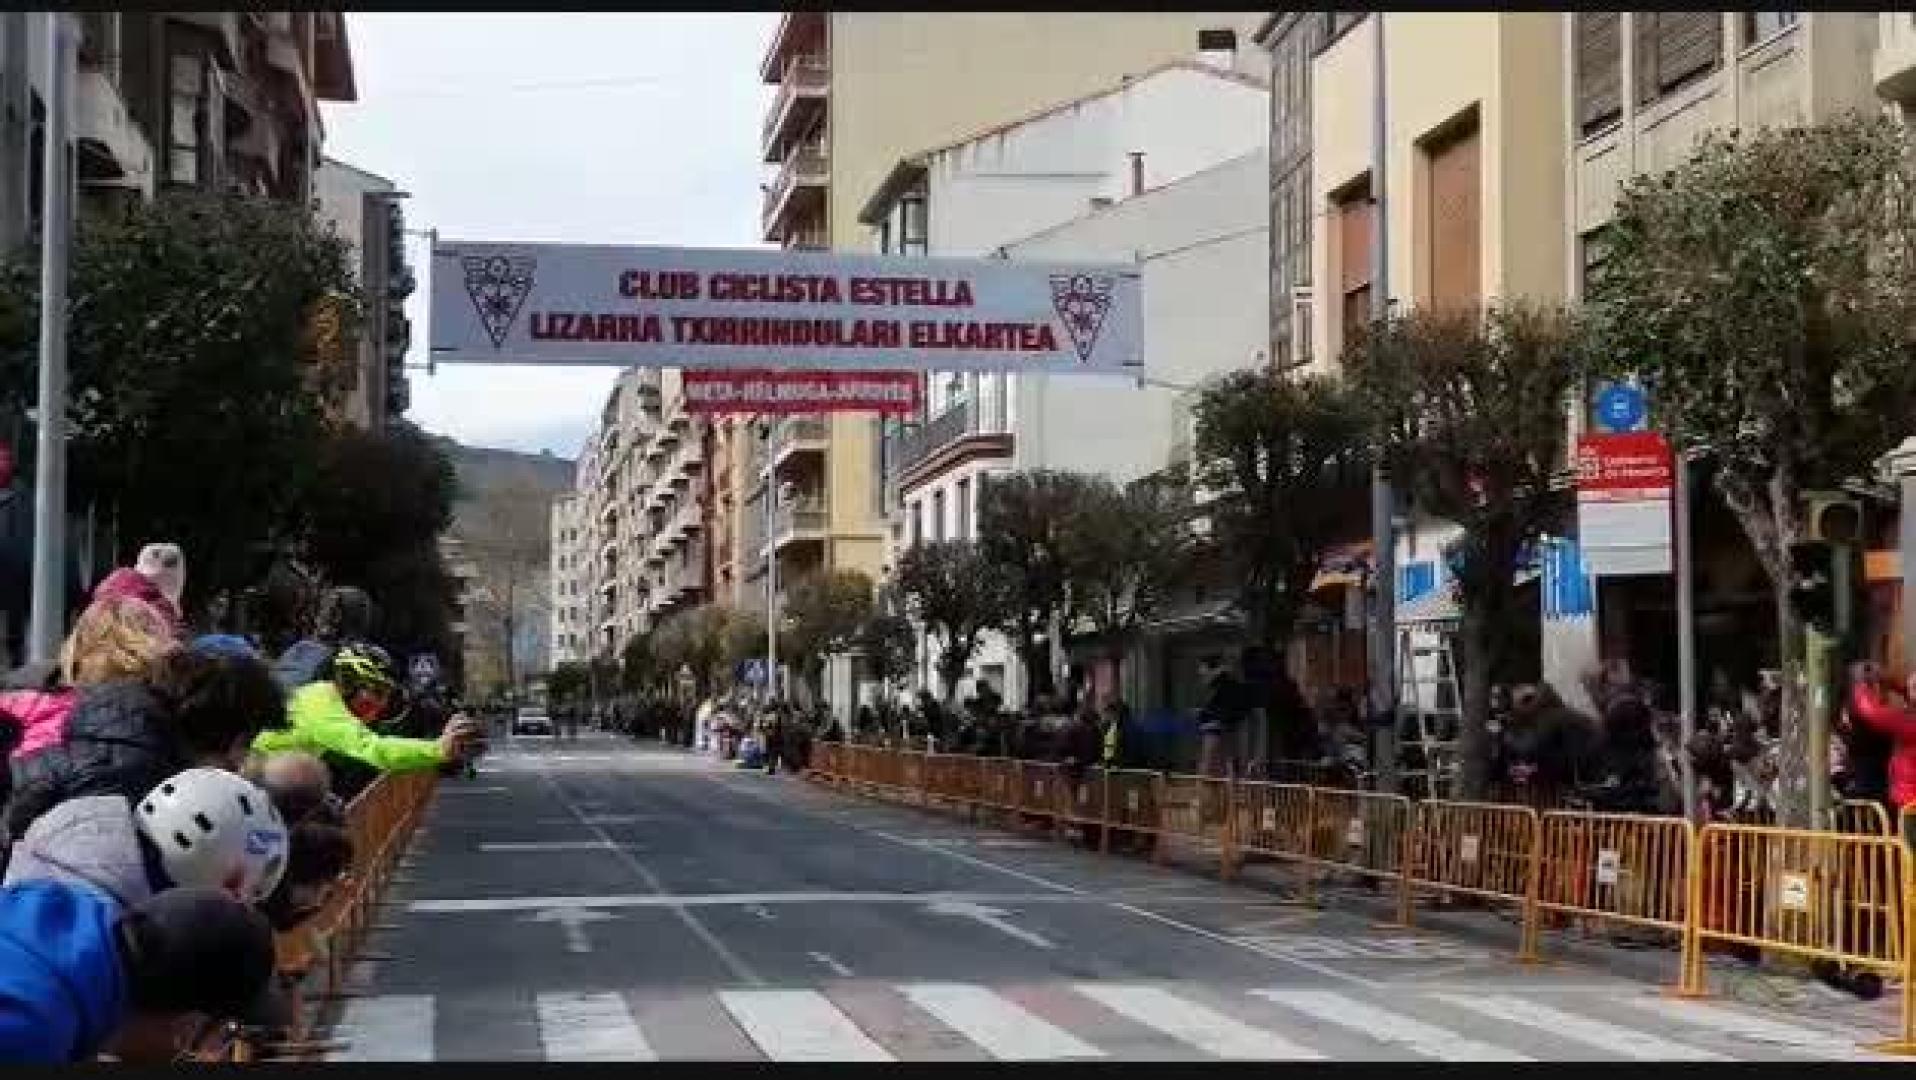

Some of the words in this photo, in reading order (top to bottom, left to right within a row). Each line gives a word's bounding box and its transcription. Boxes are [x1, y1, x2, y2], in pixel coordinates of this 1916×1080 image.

[618, 269, 700, 300] CLUB
[708, 273, 842, 303] CICLISTA
[849, 277, 973, 307] ESTELLA
[529, 313, 662, 342] LIZARRA
[669, 317, 901, 347] TXIRRINDULARI
[908, 321, 1056, 351] ELKARTEA
